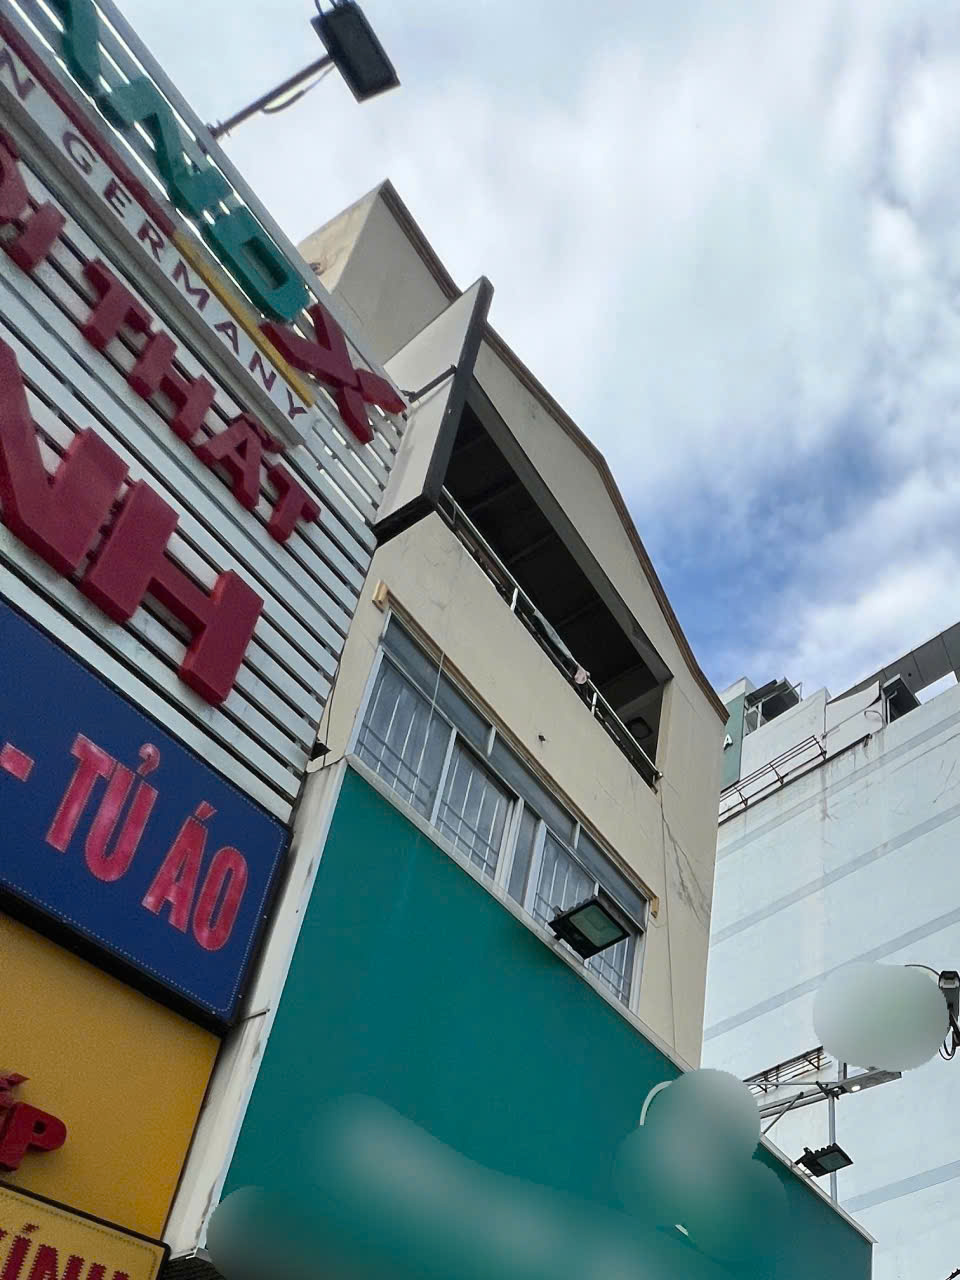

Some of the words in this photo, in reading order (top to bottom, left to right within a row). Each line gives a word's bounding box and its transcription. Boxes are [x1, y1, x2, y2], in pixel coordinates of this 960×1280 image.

[62, 130, 308, 420] GERMANY
[82, 256, 321, 545] THẤT
[45, 732, 159, 882] TỦ
[141, 800, 248, 951] ÁO
